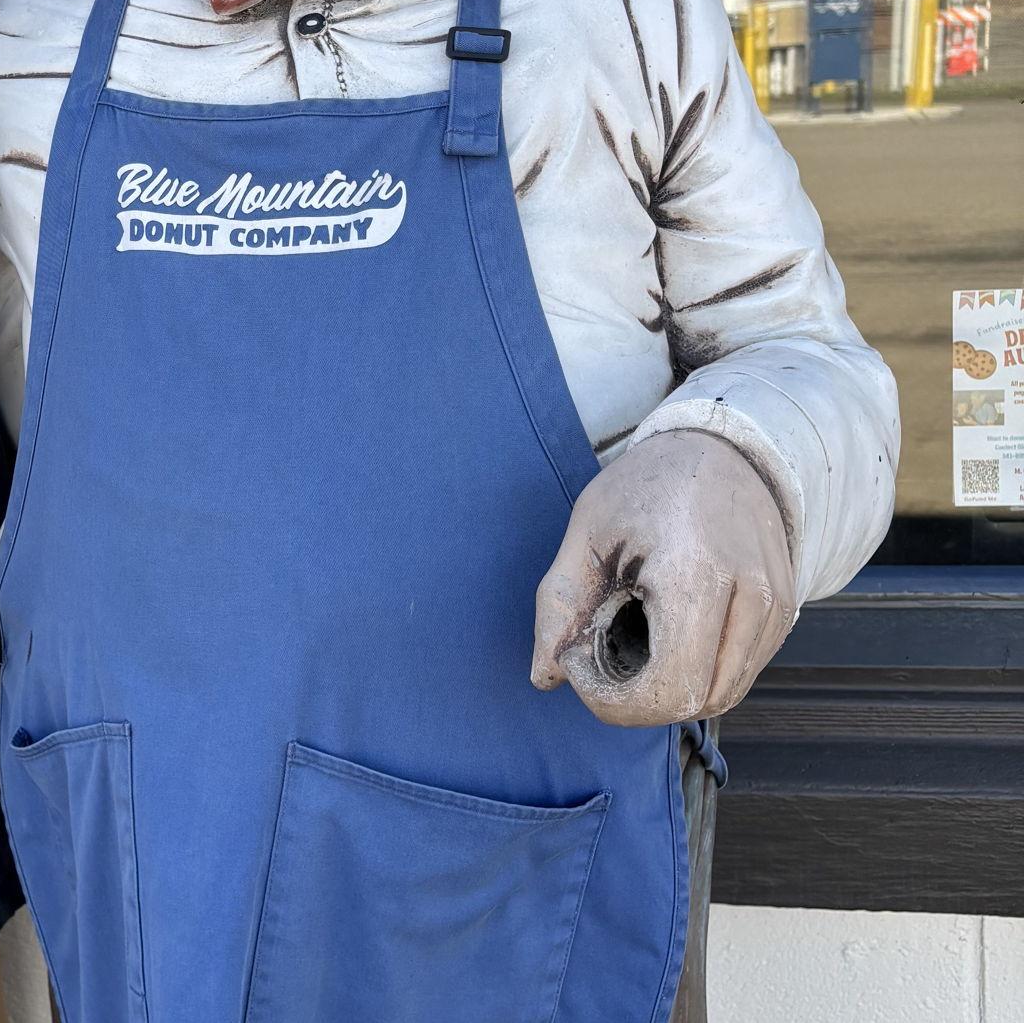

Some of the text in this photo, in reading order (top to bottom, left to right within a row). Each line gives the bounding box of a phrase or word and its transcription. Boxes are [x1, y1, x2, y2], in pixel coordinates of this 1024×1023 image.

[117, 163, 405, 218] Blue Mountain
[129, 217, 374, 249] DONUT COMPANY
